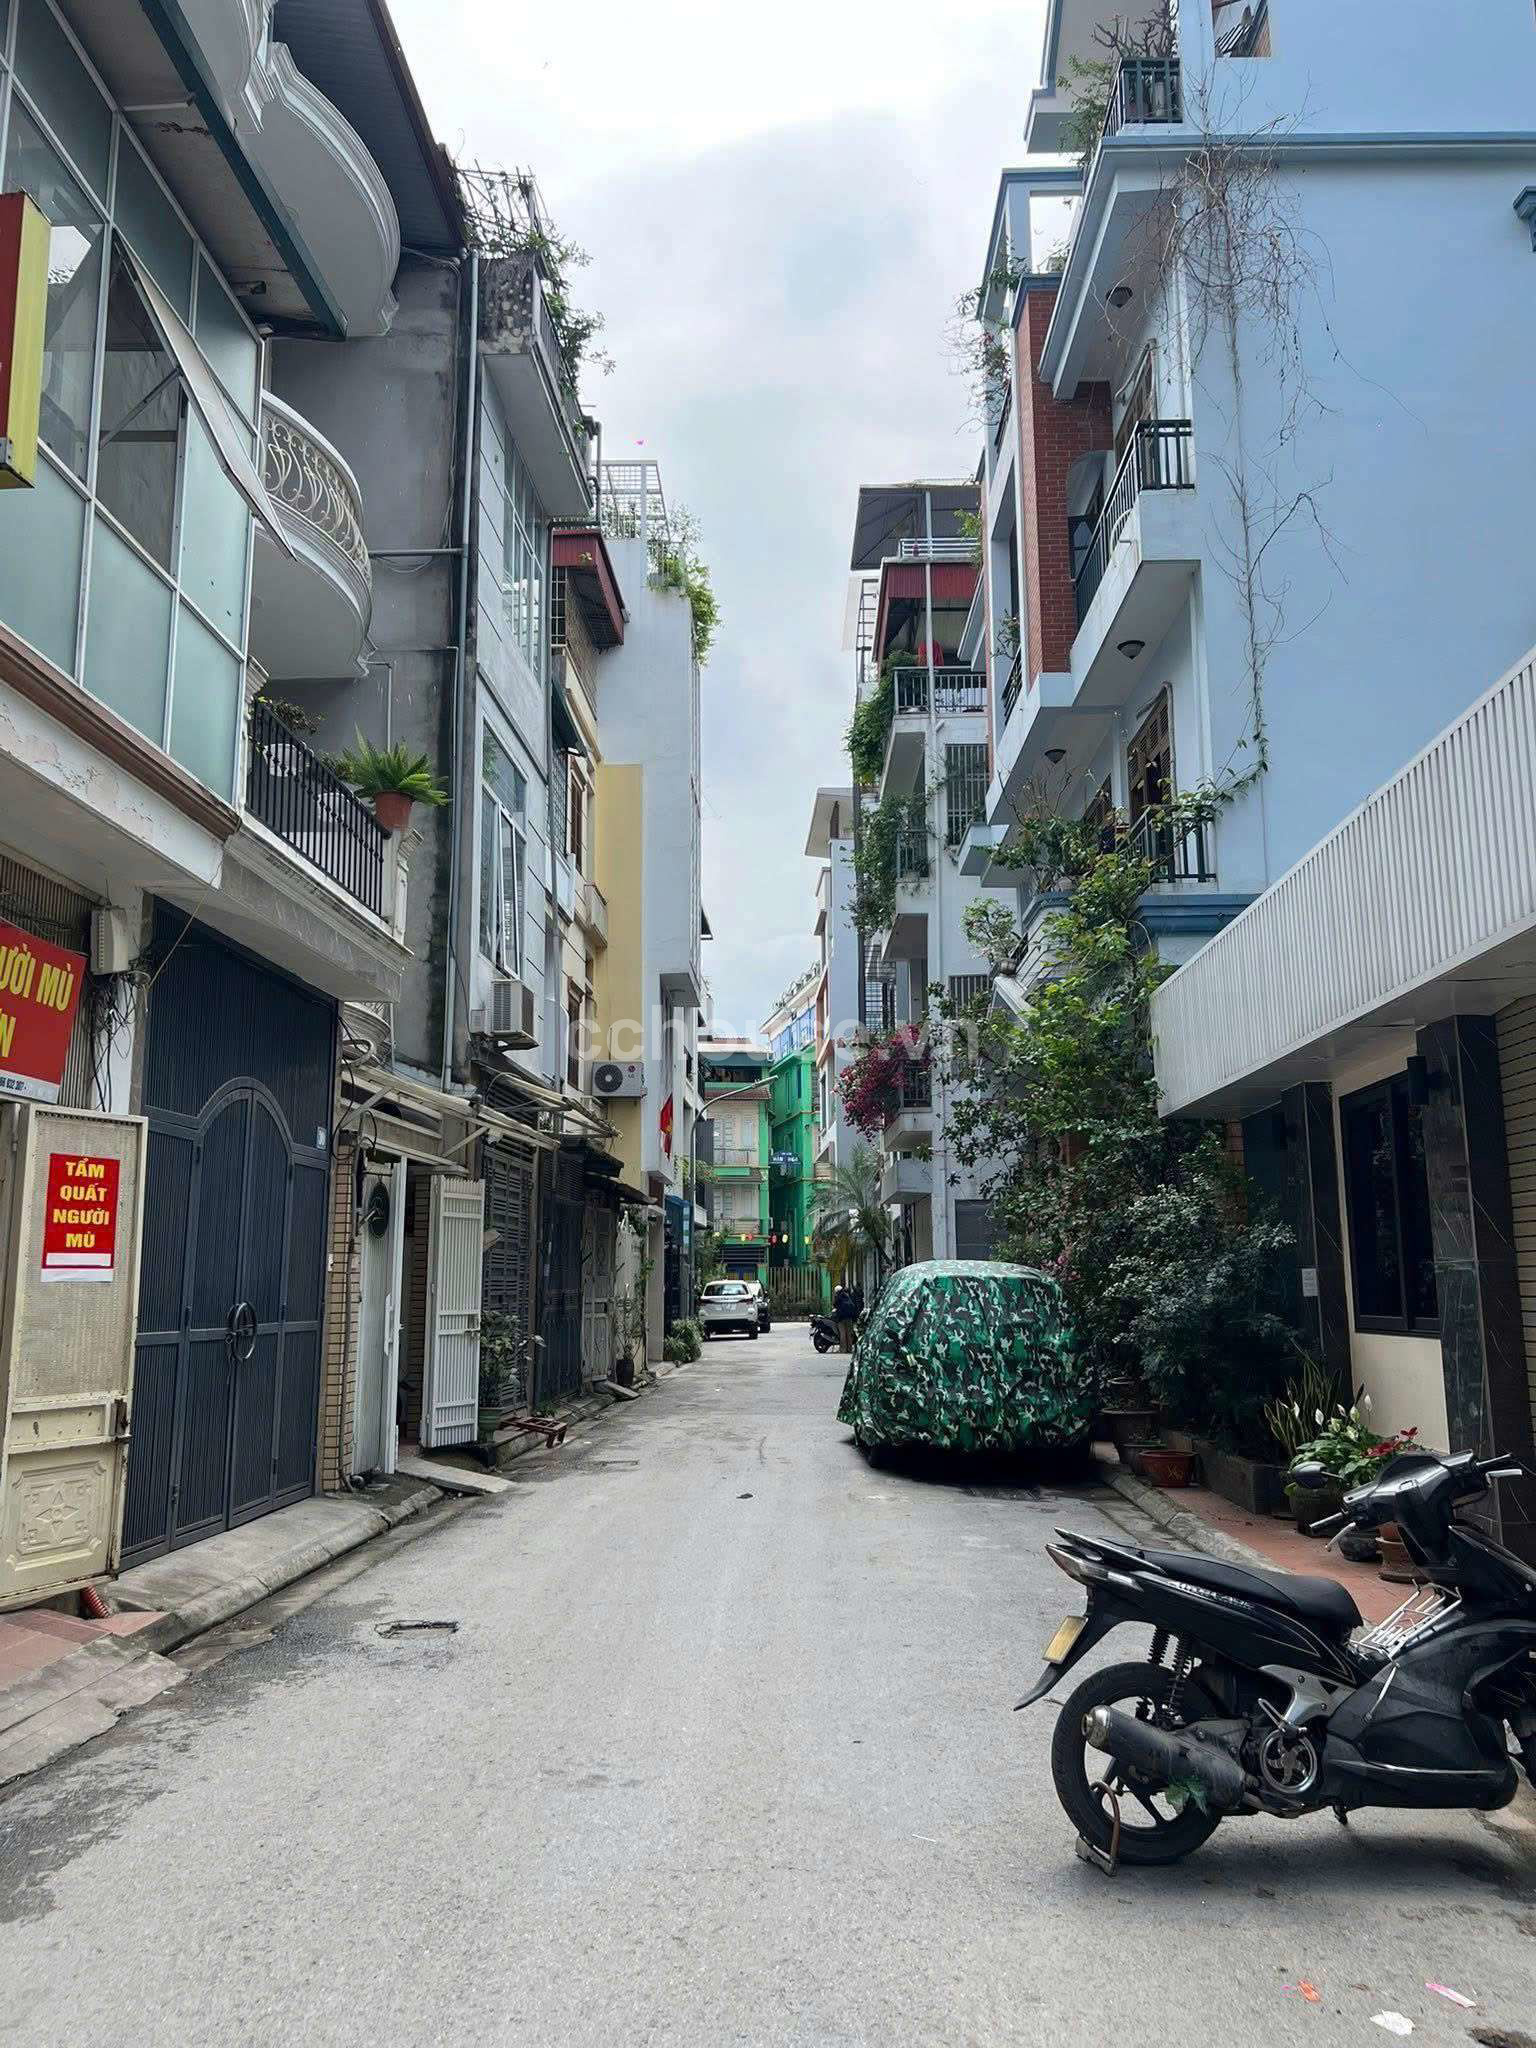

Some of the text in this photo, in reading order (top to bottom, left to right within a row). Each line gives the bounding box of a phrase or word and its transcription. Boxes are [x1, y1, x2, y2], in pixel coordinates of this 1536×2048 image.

[36, 963, 74, 1012] MÙ
[60, 1183, 107, 1202] QUẤT
[53, 1207, 110, 1225] NGƯỜI
[65, 1231, 95, 1248] MÙ
